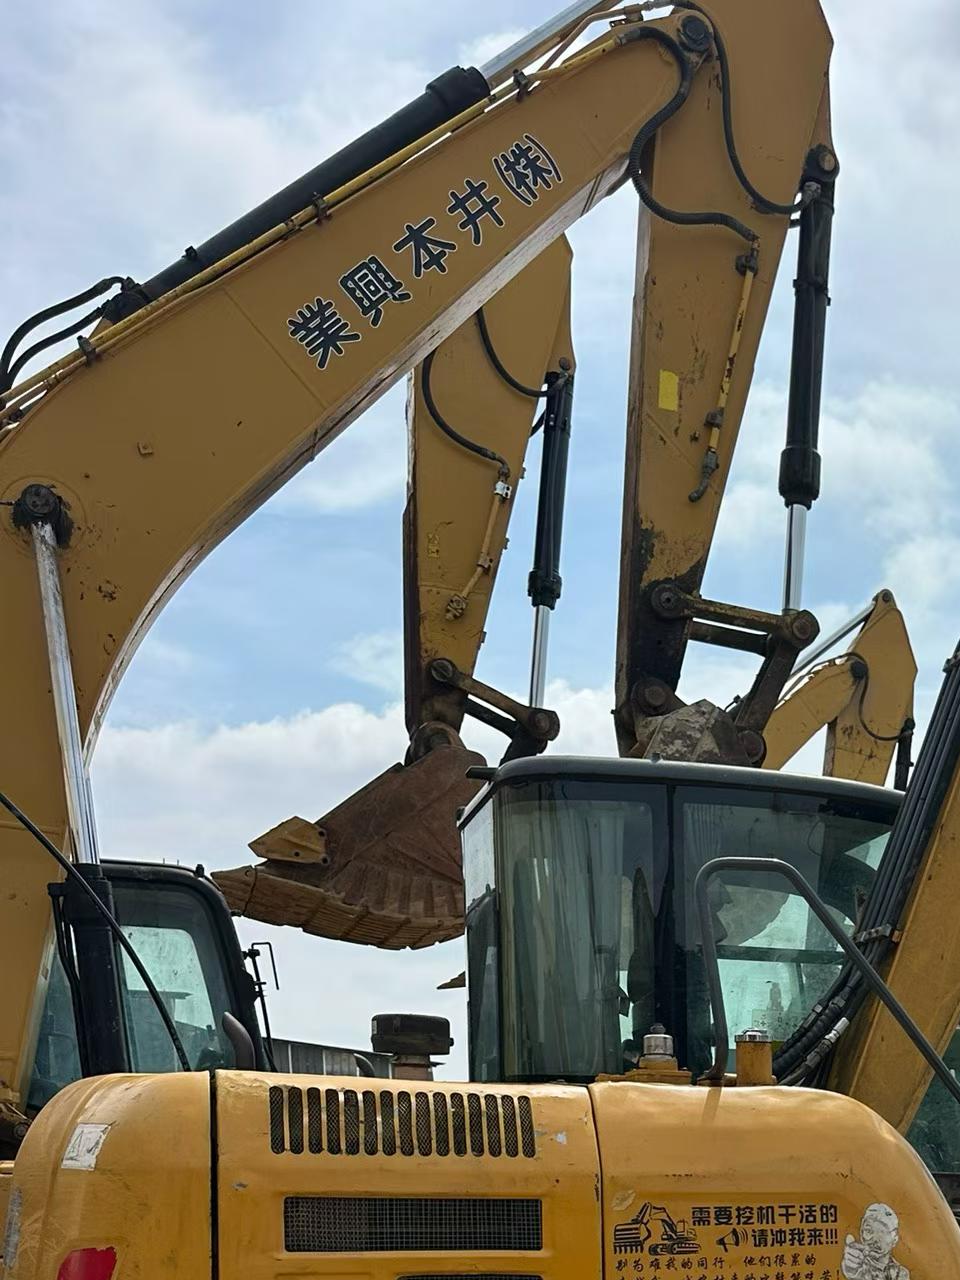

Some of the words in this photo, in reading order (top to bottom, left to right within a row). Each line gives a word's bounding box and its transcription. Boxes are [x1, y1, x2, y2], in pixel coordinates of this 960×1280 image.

[691, 1204, 838, 1226] 需要挖机干活的
